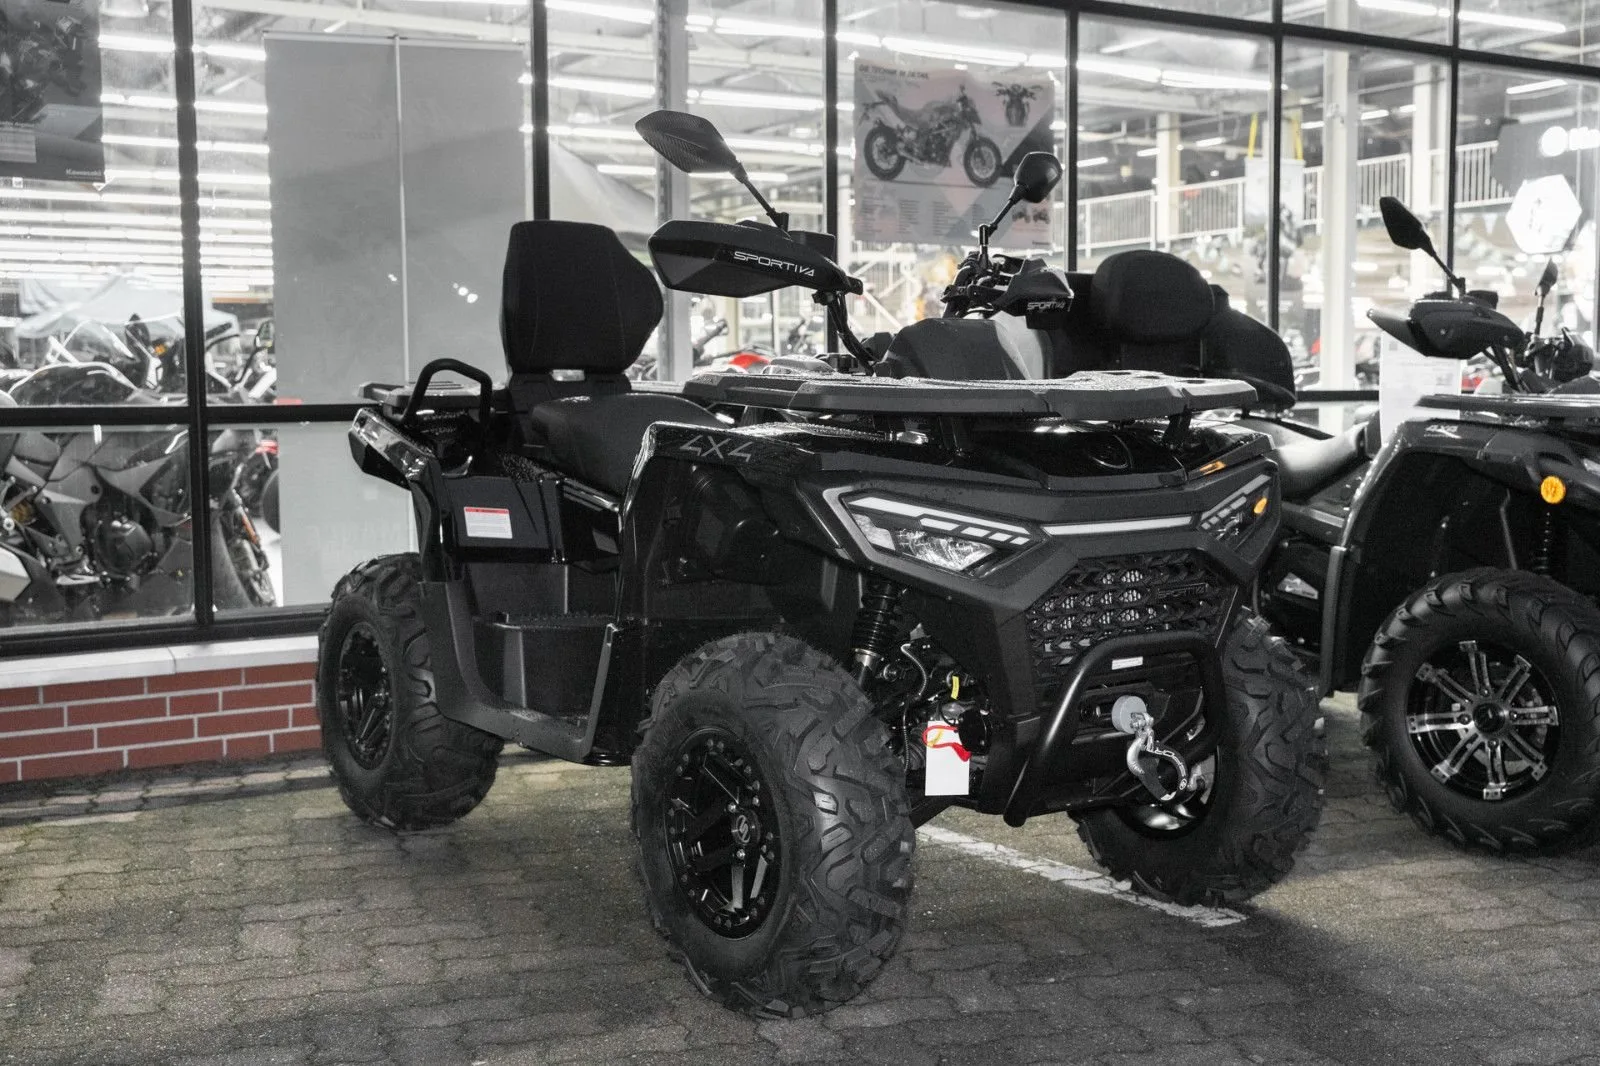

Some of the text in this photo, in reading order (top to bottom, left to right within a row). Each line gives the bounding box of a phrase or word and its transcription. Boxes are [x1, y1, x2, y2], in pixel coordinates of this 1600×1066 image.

[733, 250, 816, 277] SPORTIVA
[1026, 301, 1067, 310] SPORTIVA
[679, 434, 754, 463] 4X4
